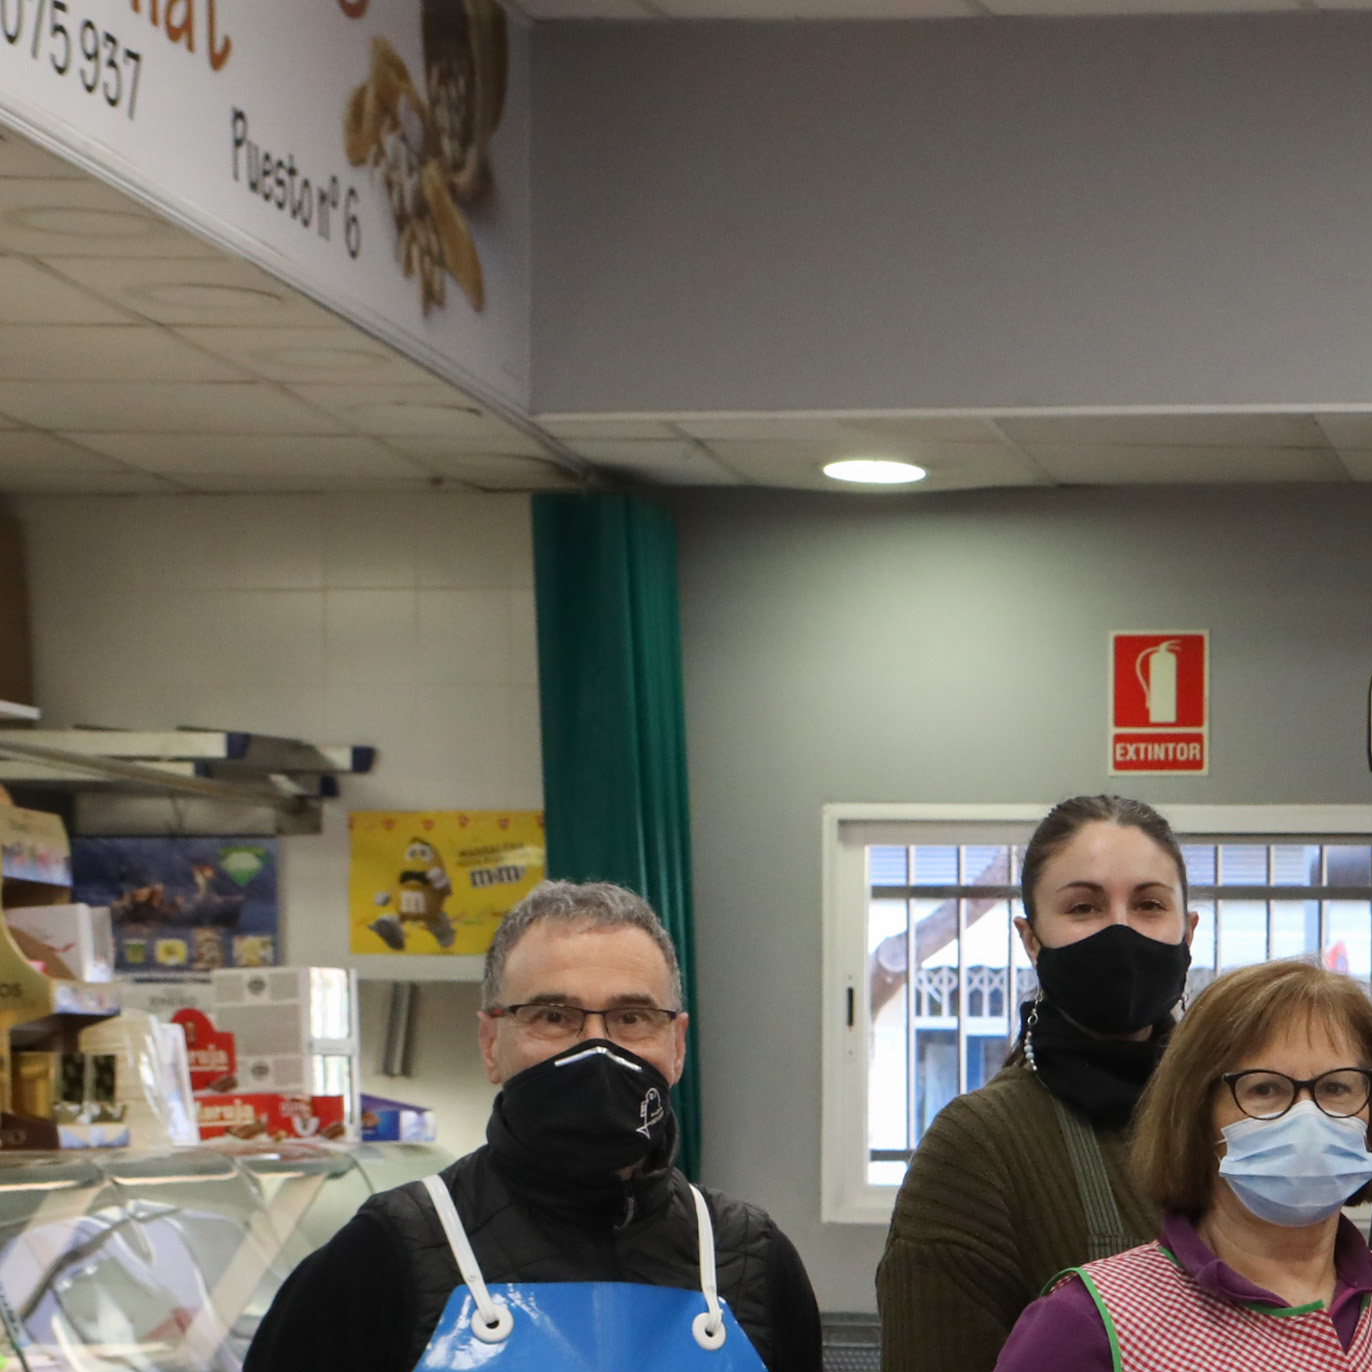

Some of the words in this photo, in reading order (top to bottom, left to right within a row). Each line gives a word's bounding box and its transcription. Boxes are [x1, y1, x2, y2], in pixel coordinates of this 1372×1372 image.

[231, 106, 313, 228] Puesto
[344, 186, 361, 260] 6
[1115, 741, 1202, 761] EXTINTOR
